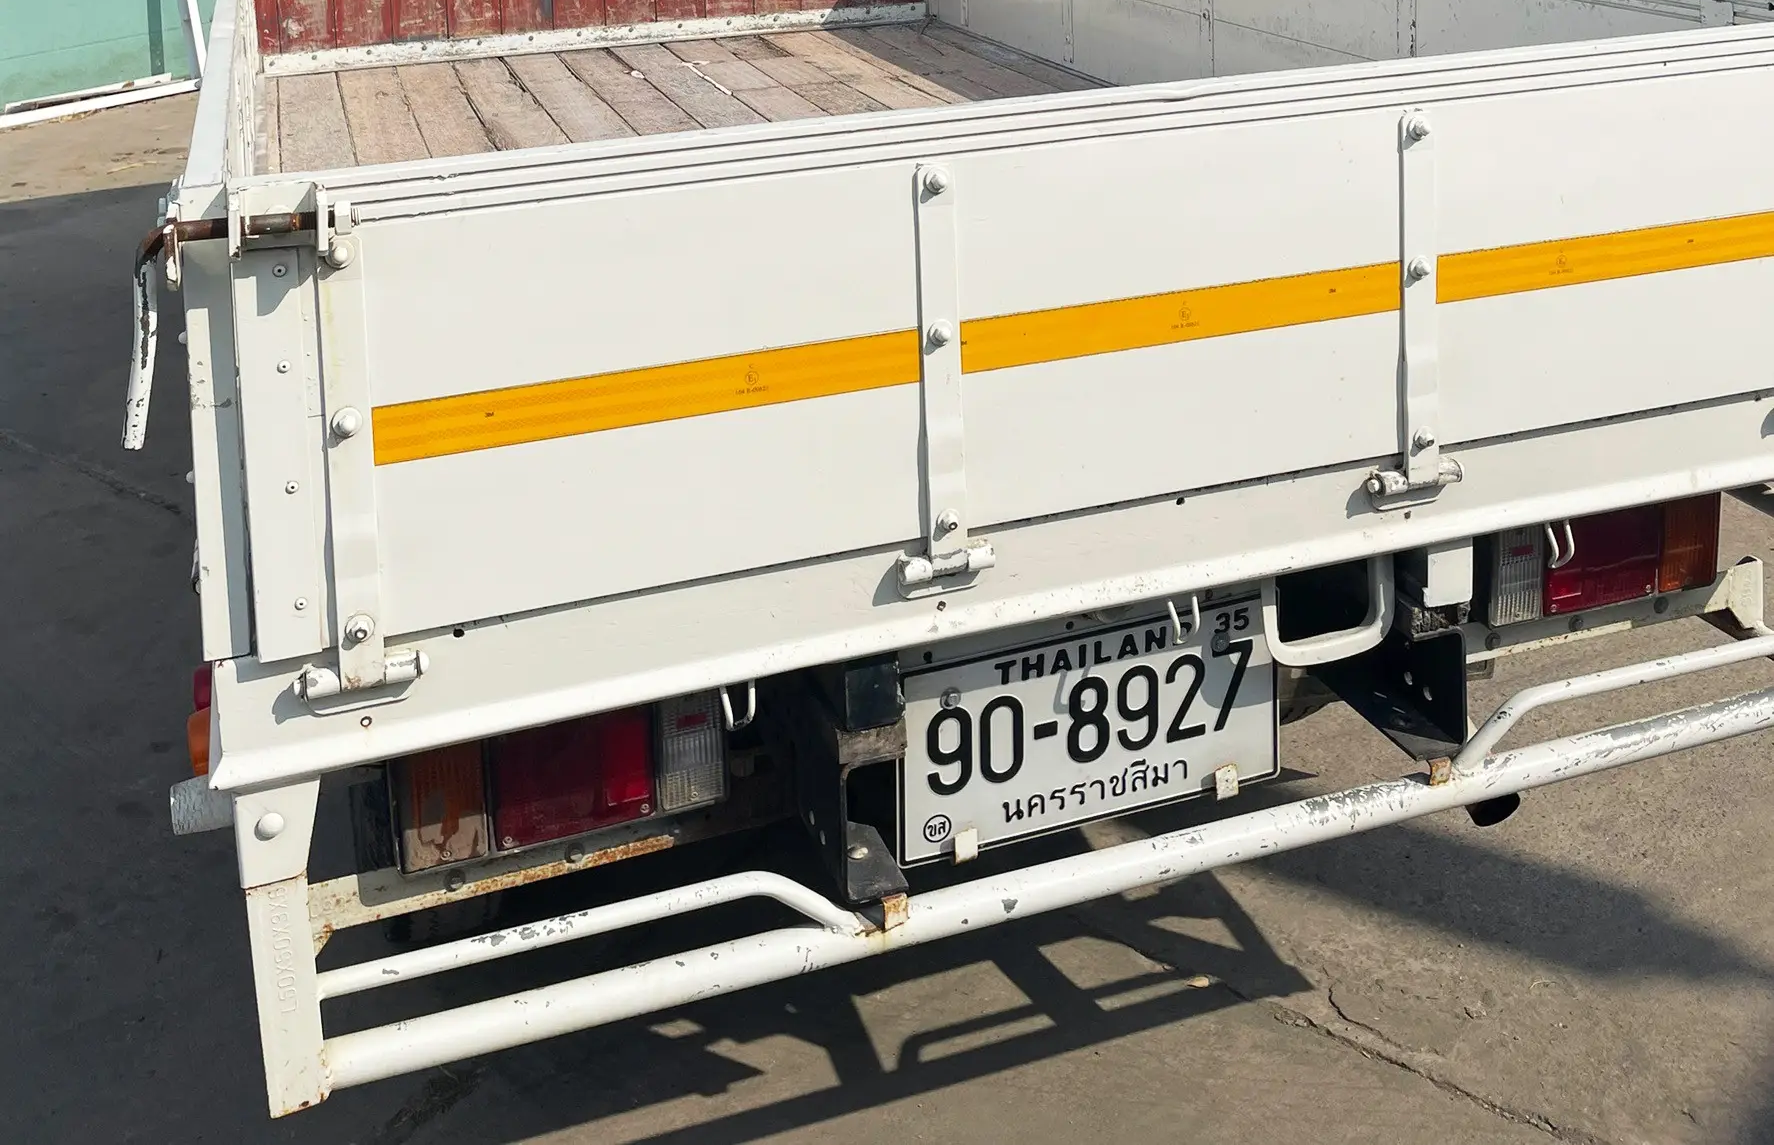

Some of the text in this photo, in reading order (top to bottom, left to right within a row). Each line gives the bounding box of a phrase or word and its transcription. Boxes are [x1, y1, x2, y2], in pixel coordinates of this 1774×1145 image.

[1214, 607, 1250, 634] 35
[926, 639, 1254, 796] 90-8927
[1002, 758, 1188, 823] นครราชสีมา
[926, 820, 947, 837] ขส
